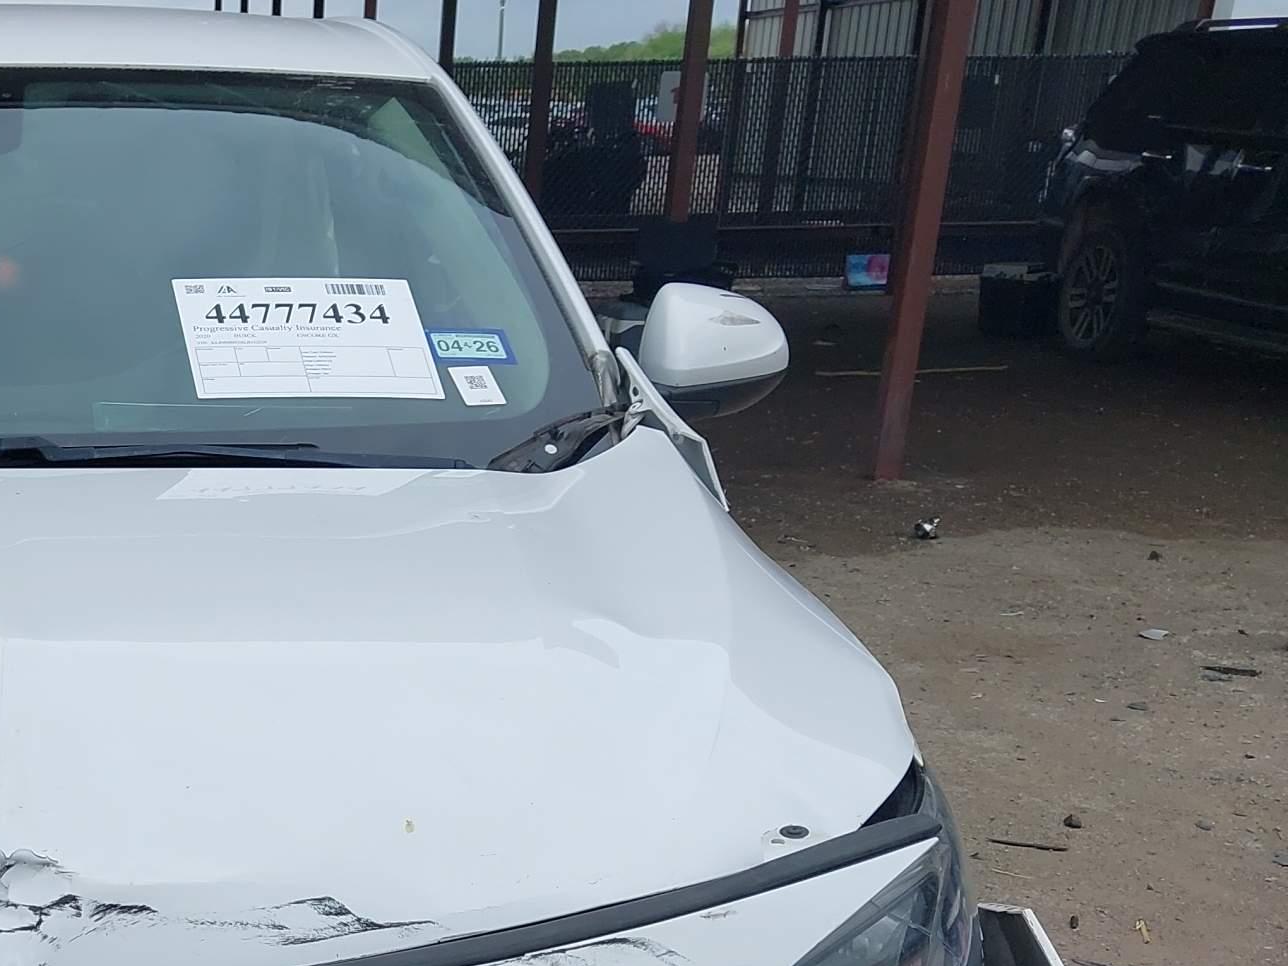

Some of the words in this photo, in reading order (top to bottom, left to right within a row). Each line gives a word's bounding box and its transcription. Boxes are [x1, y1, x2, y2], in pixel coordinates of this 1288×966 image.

[205, 303, 391, 324] 44777434
[193, 325, 248, 333] Progressive
[251, 324, 292, 333] Casualty
[437, 340, 463, 352] 04
[473, 340, 499, 353] 26
